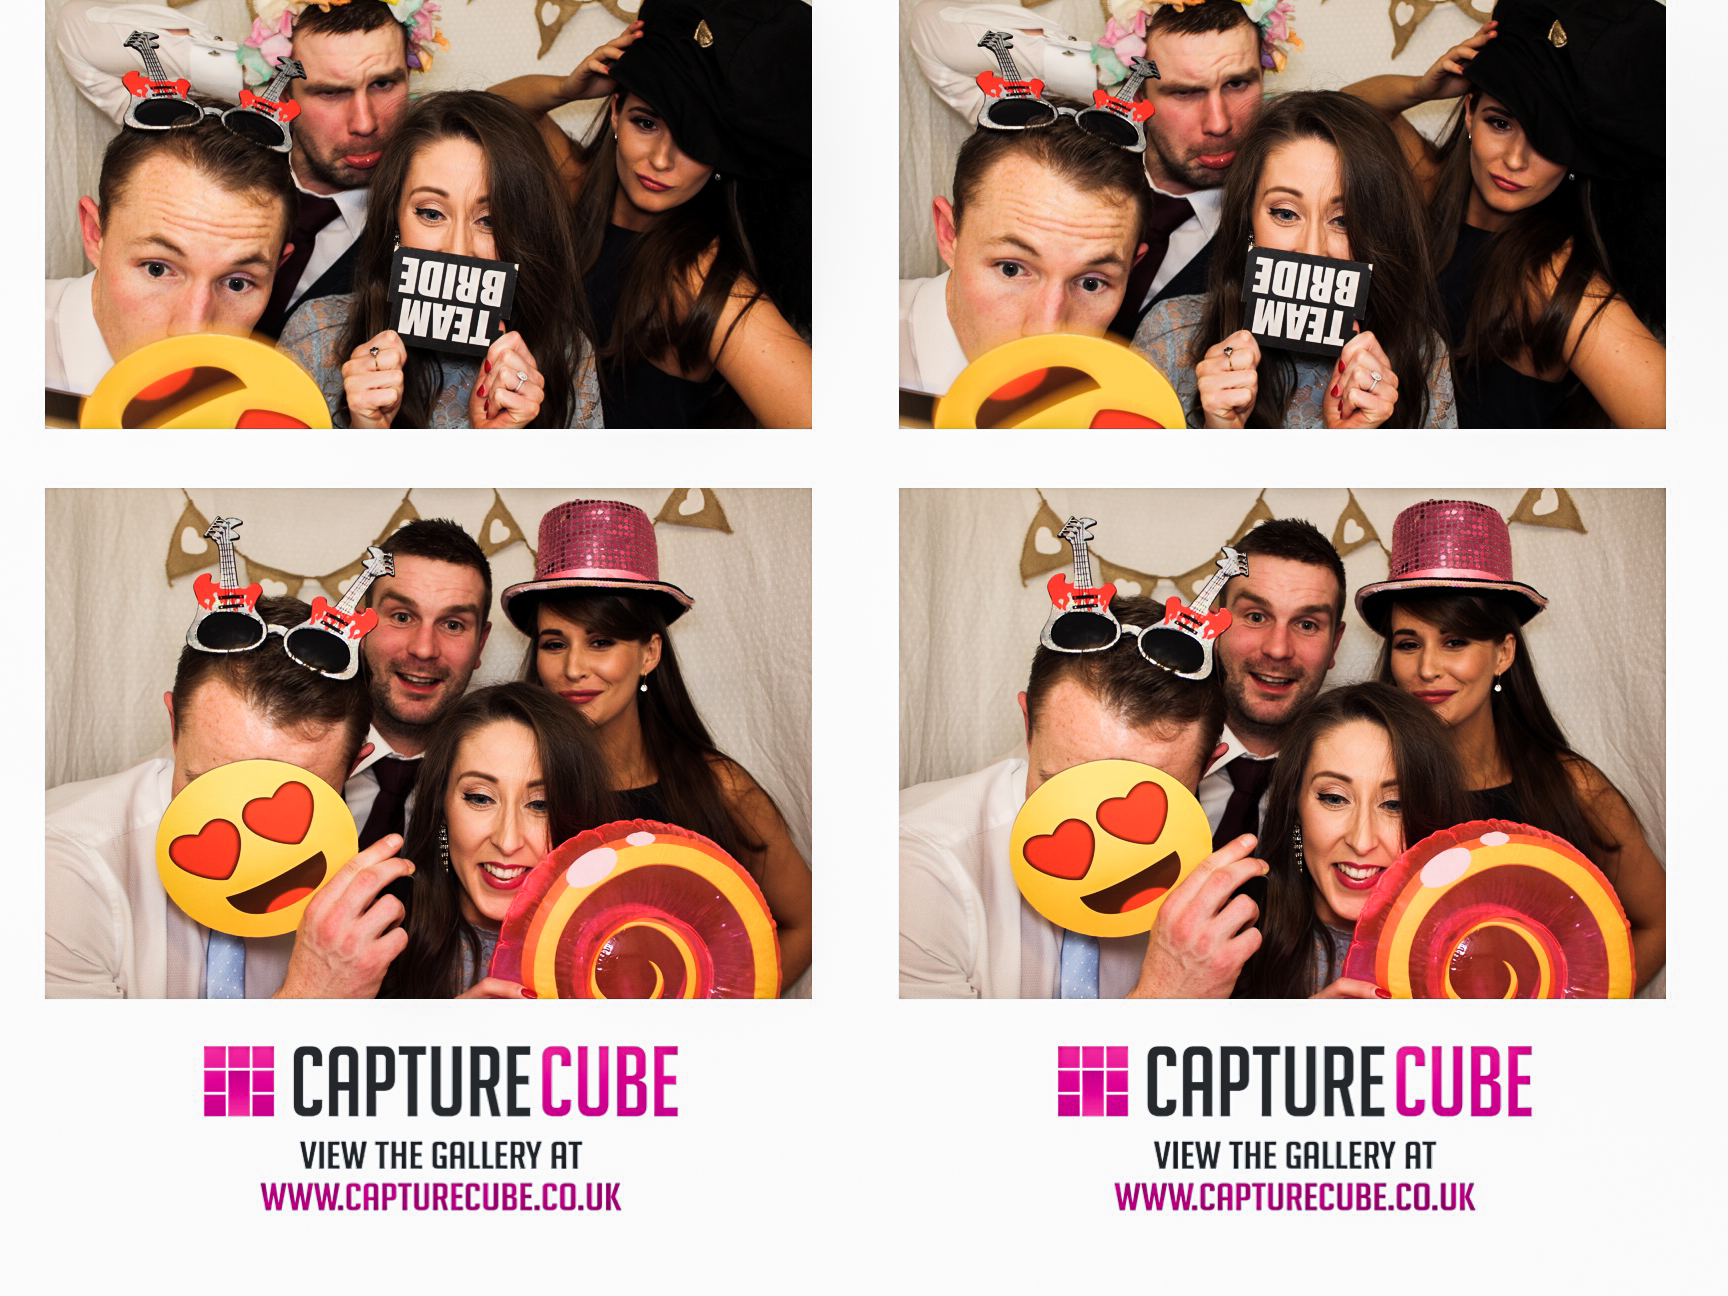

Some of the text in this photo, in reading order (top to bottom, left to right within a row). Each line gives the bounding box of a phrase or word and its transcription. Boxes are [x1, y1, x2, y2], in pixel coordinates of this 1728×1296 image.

[397, 256, 507, 308] BRIDE
[1251, 256, 1361, 308] BRIDE
[397, 297, 491, 347] TEAM
[1251, 297, 1345, 347] TEAM
